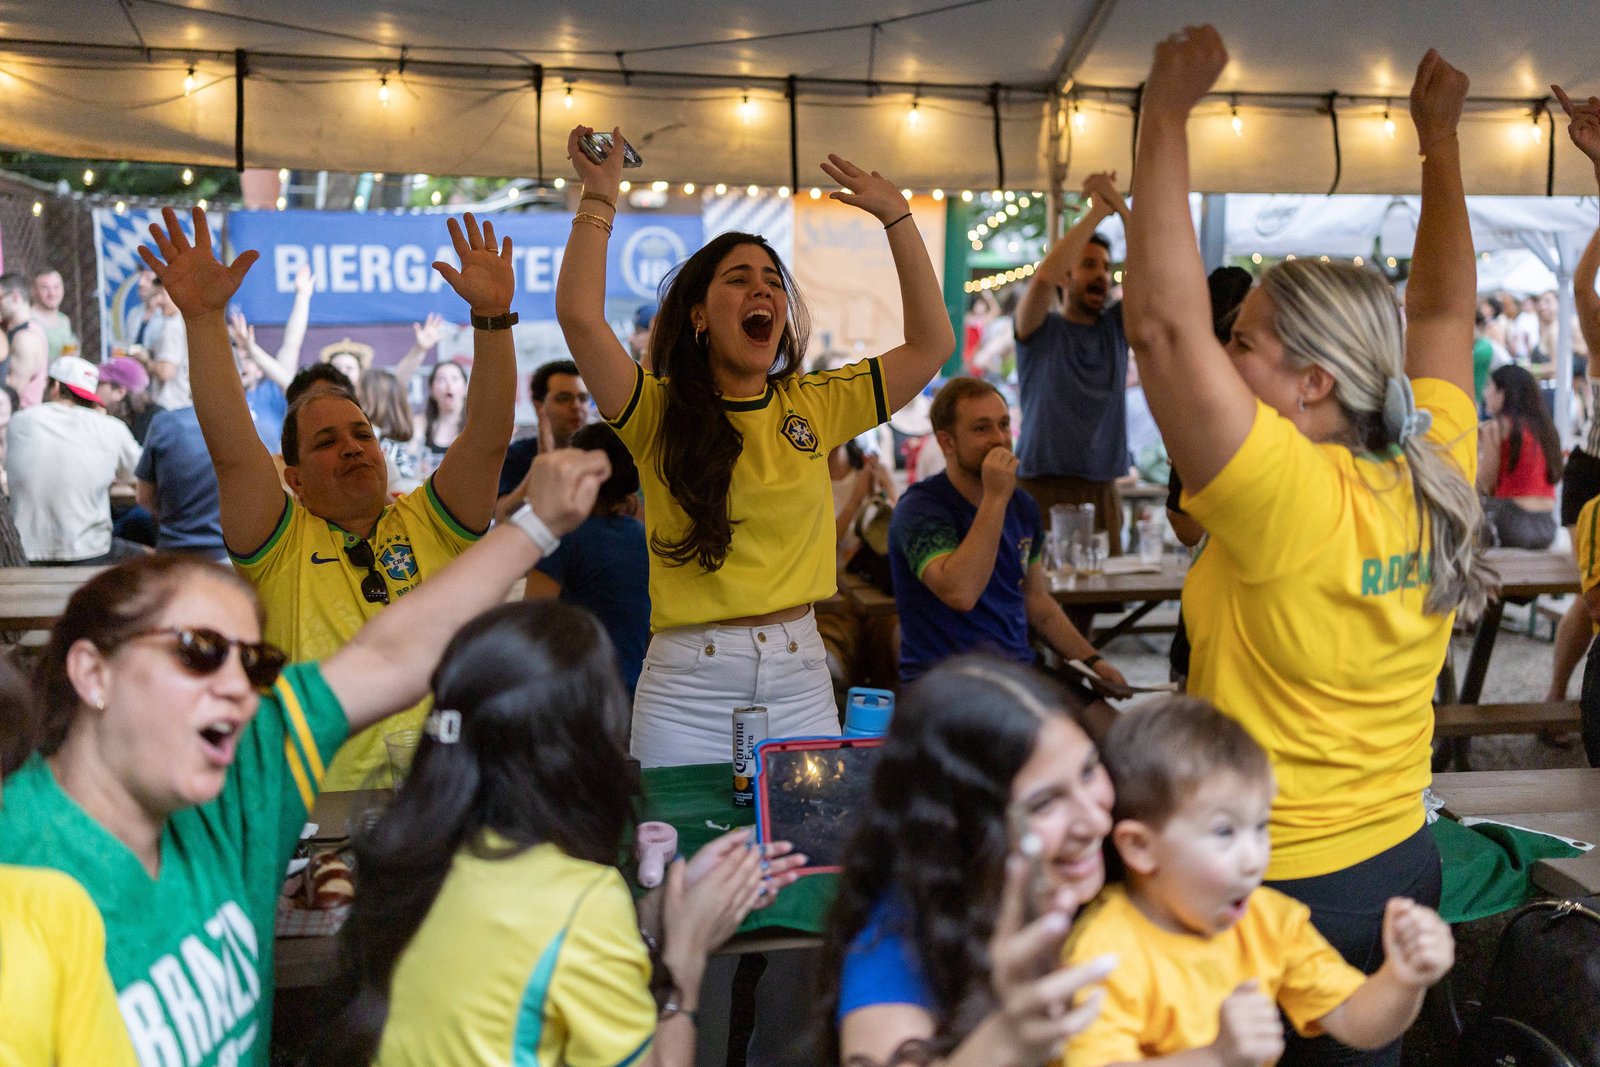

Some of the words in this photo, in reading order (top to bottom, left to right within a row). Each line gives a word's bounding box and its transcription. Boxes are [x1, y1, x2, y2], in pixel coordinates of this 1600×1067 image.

[275, 244, 568, 293] BIERGAE
[735, 722, 747, 773] Corona
[745, 735, 754, 760] Extra
